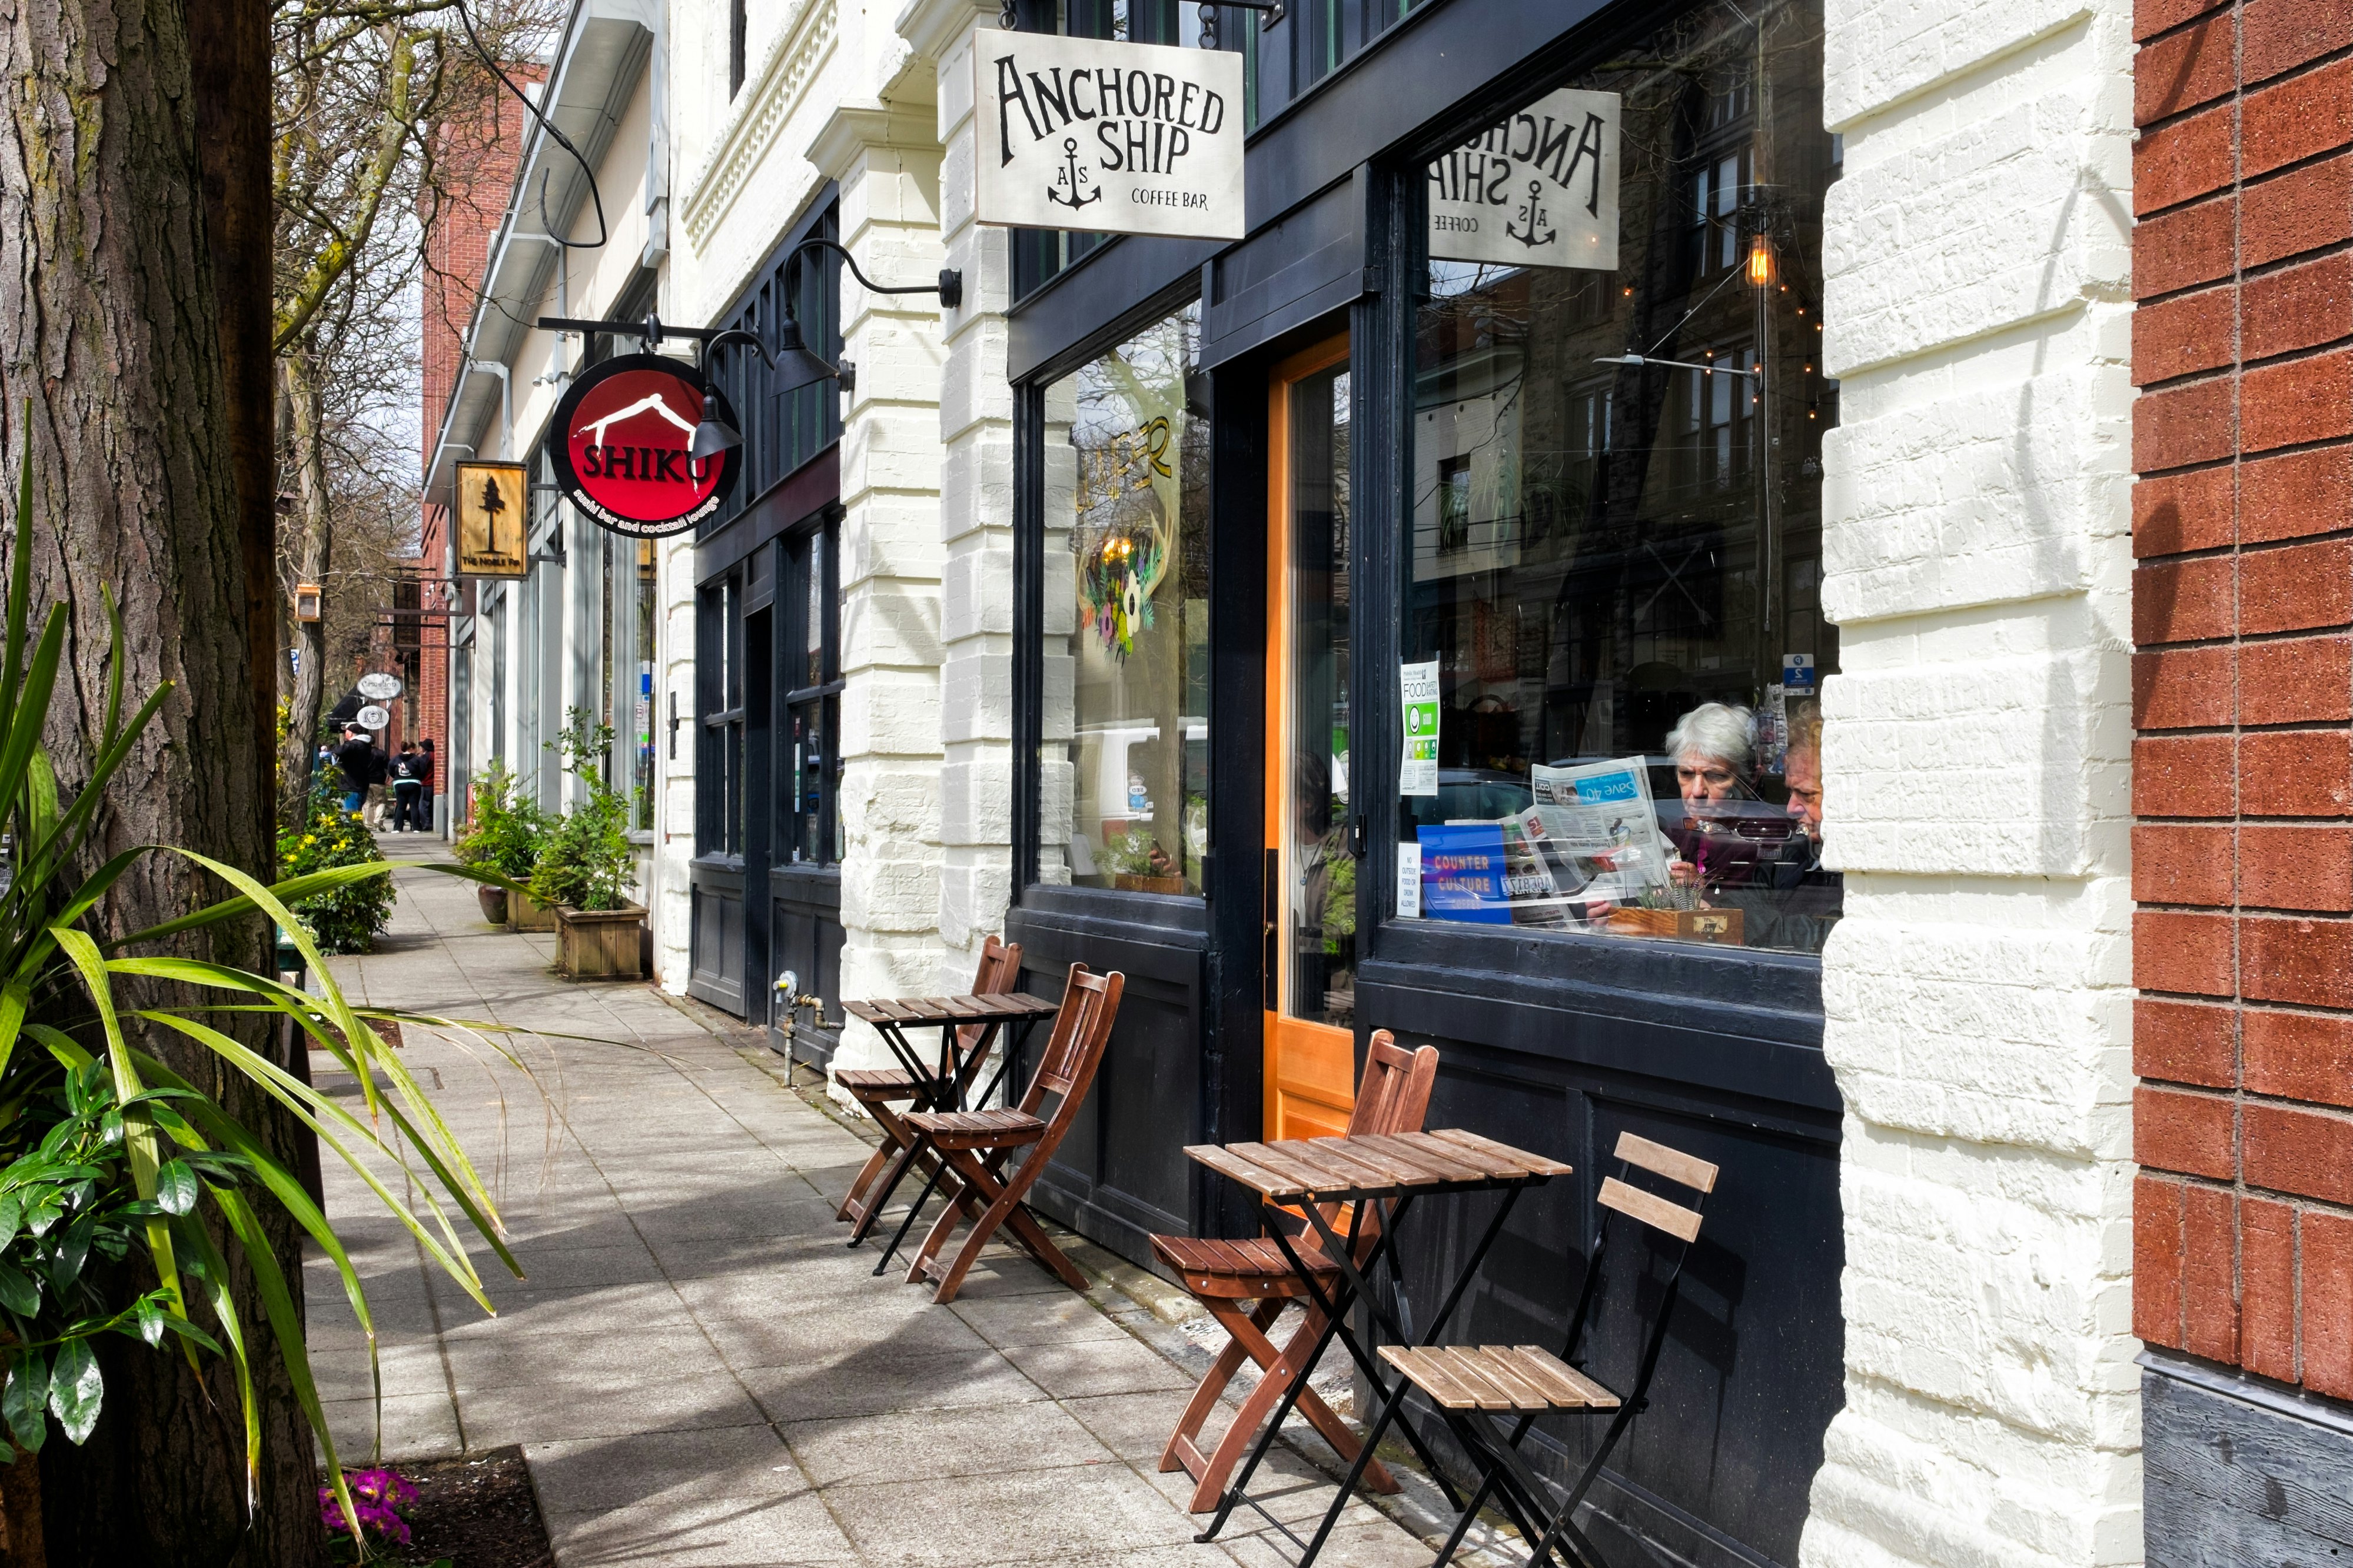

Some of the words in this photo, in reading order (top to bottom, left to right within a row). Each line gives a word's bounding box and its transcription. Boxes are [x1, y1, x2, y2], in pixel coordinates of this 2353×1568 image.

[993, 54, 1224, 168] ANCHORED
[1097, 119, 1189, 175] SHIP
[1132, 188, 1179, 207] COFFEE
[1182, 192, 1209, 211] BAR
[583, 444, 712, 482] SHIKU
[573, 488, 599, 515] sushi
[597, 507, 618, 525] bar
[617, 520, 640, 533] and
[640, 517, 687, 534] cocktail
[687, 495, 720, 524] lounge
[1404, 683, 1427, 698] FOOD
[1606, 781, 1636, 795] Save
[1434, 855, 1489, 870] COUNTER
[1402, 867, 1416, 875] OUTSIDE
[1438, 877, 1490, 892] CULTURE
[1401, 900, 1416, 908] ALLOWED
